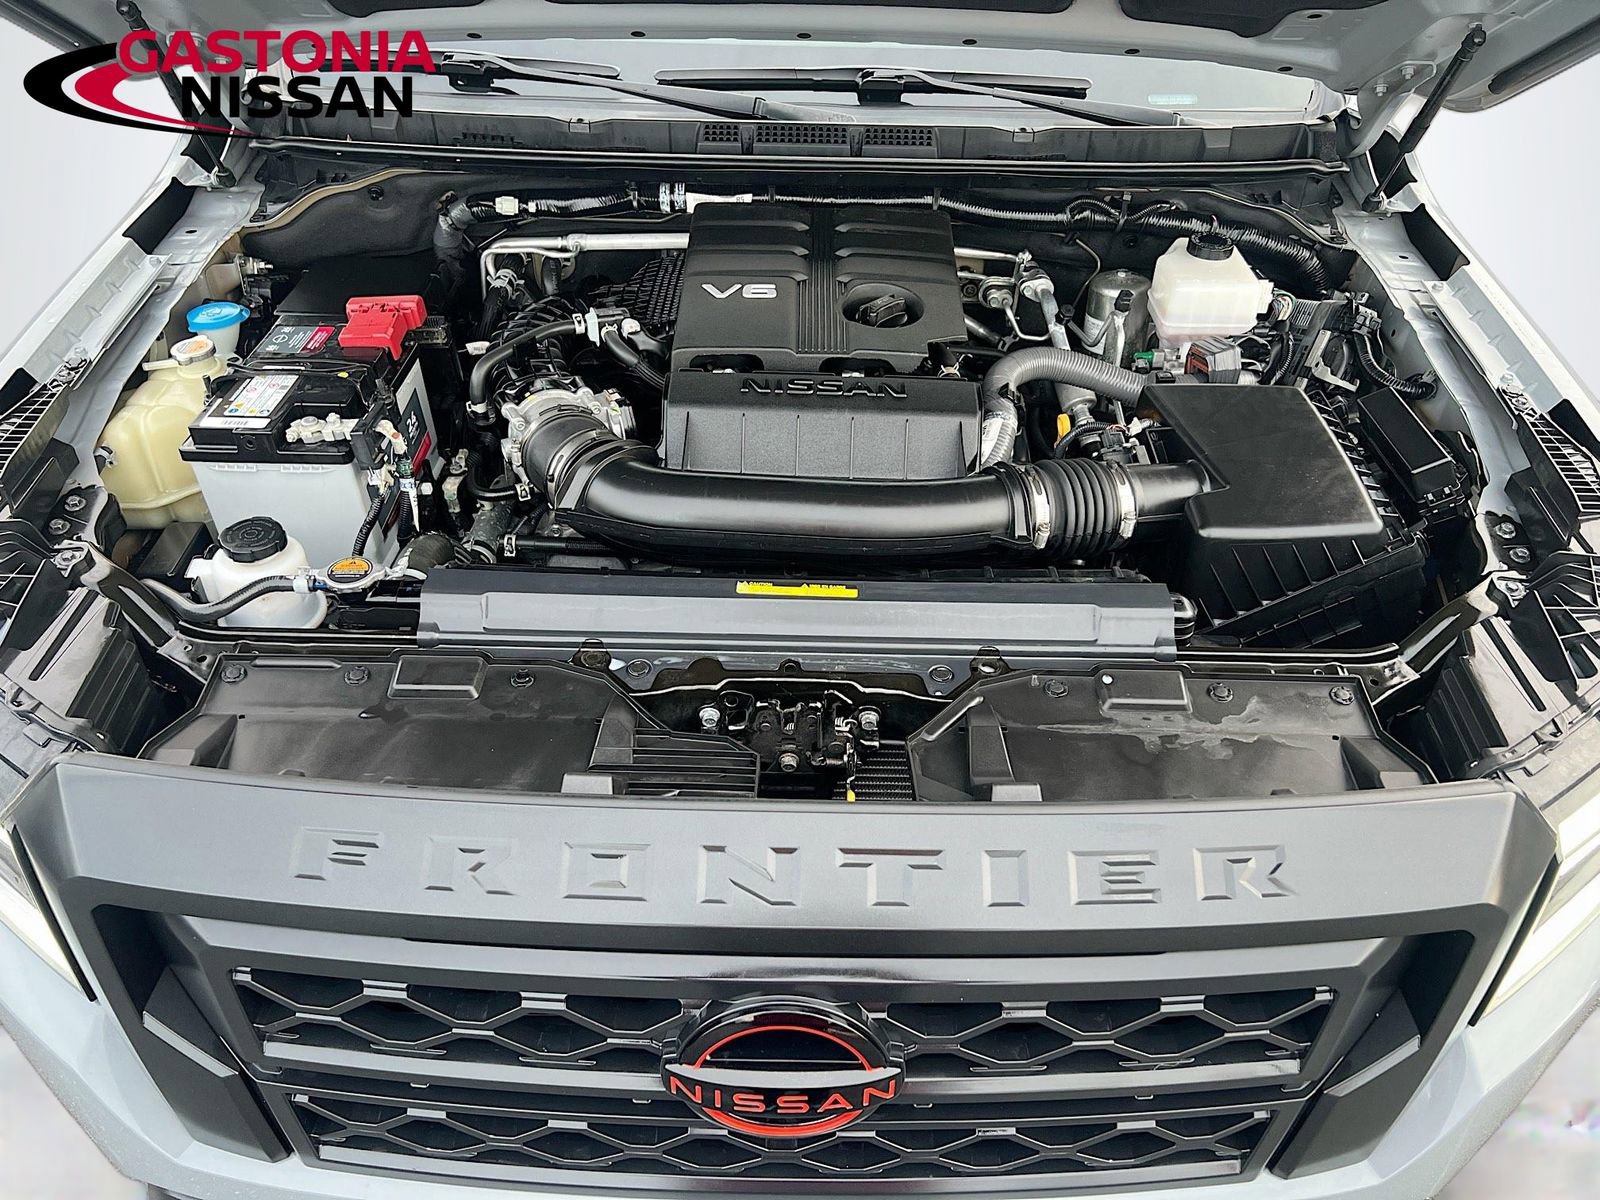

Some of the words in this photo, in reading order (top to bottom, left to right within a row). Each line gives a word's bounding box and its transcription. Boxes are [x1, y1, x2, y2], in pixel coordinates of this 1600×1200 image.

[701, 283, 777, 299] V6
[740, 377, 908, 398] NISSAN
[290, 826, 1293, 906] FRONTIER
[669, 1076, 897, 1114] NISSAN
